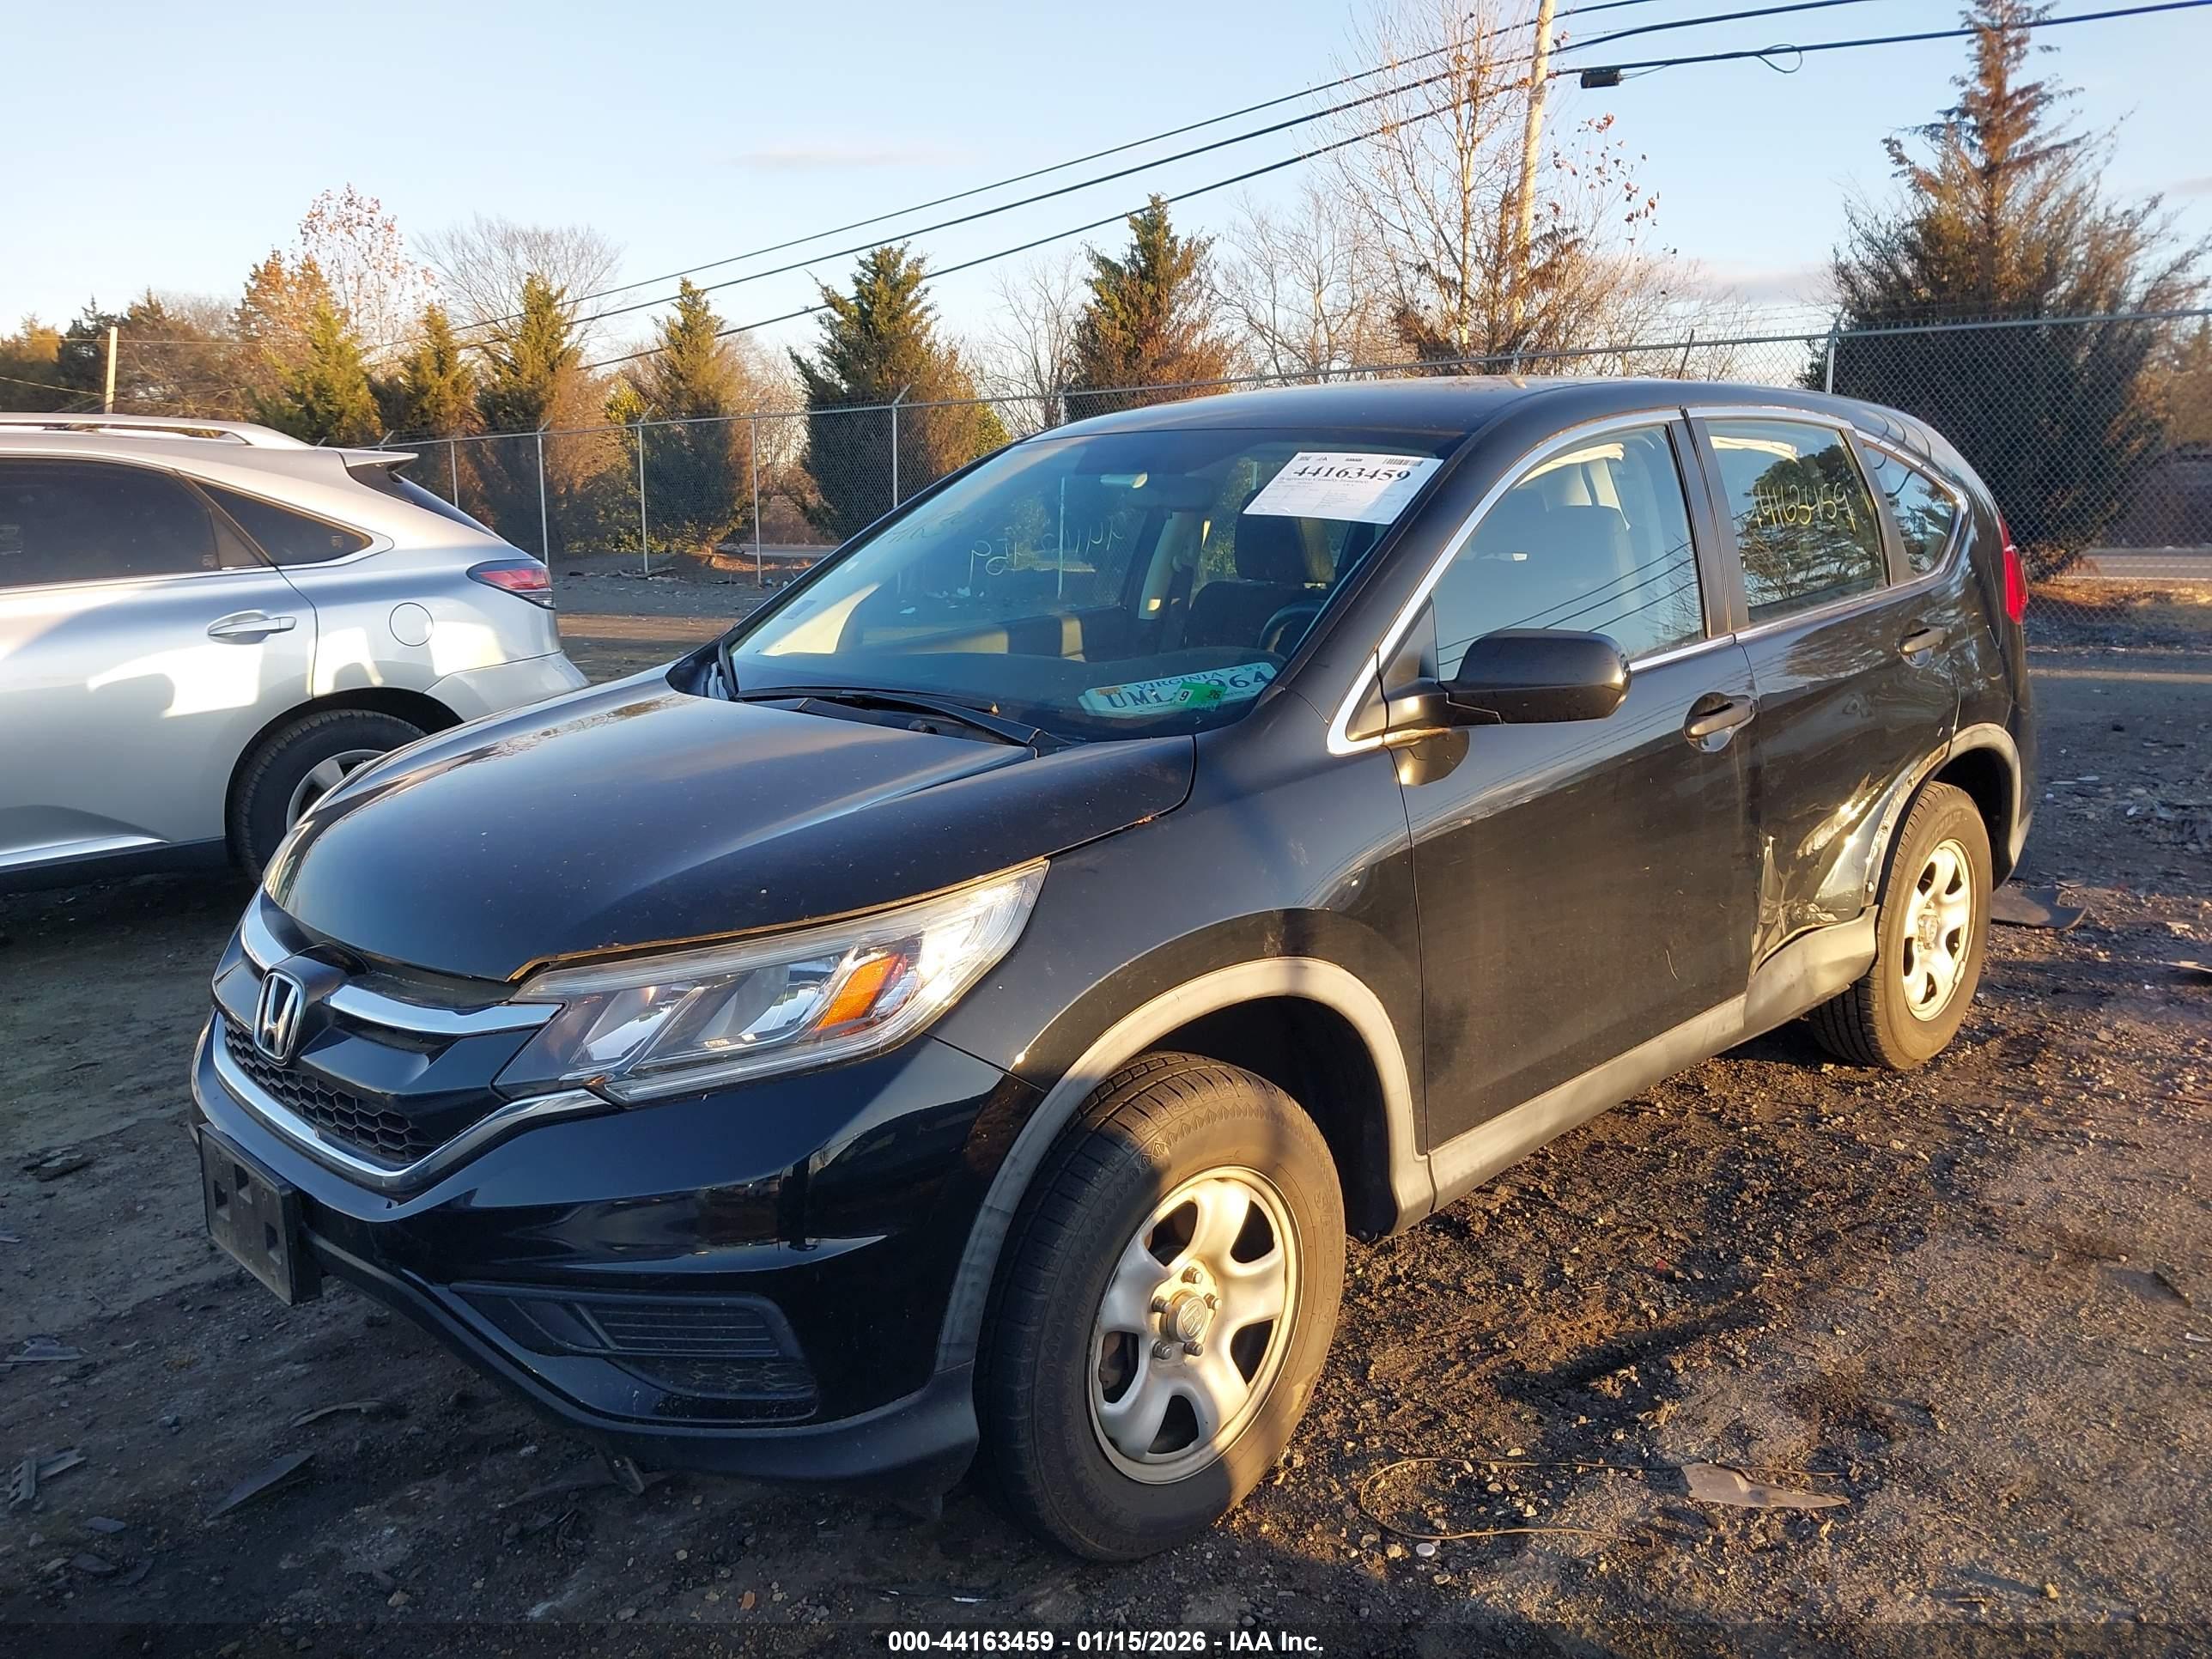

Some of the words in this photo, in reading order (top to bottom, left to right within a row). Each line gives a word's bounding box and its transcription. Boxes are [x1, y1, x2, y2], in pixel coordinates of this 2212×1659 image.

[1292, 465, 1411, 482] 44163459
[1133, 672, 1224, 690] VIRGINIA
[1179, 690, 1189, 702] 9
